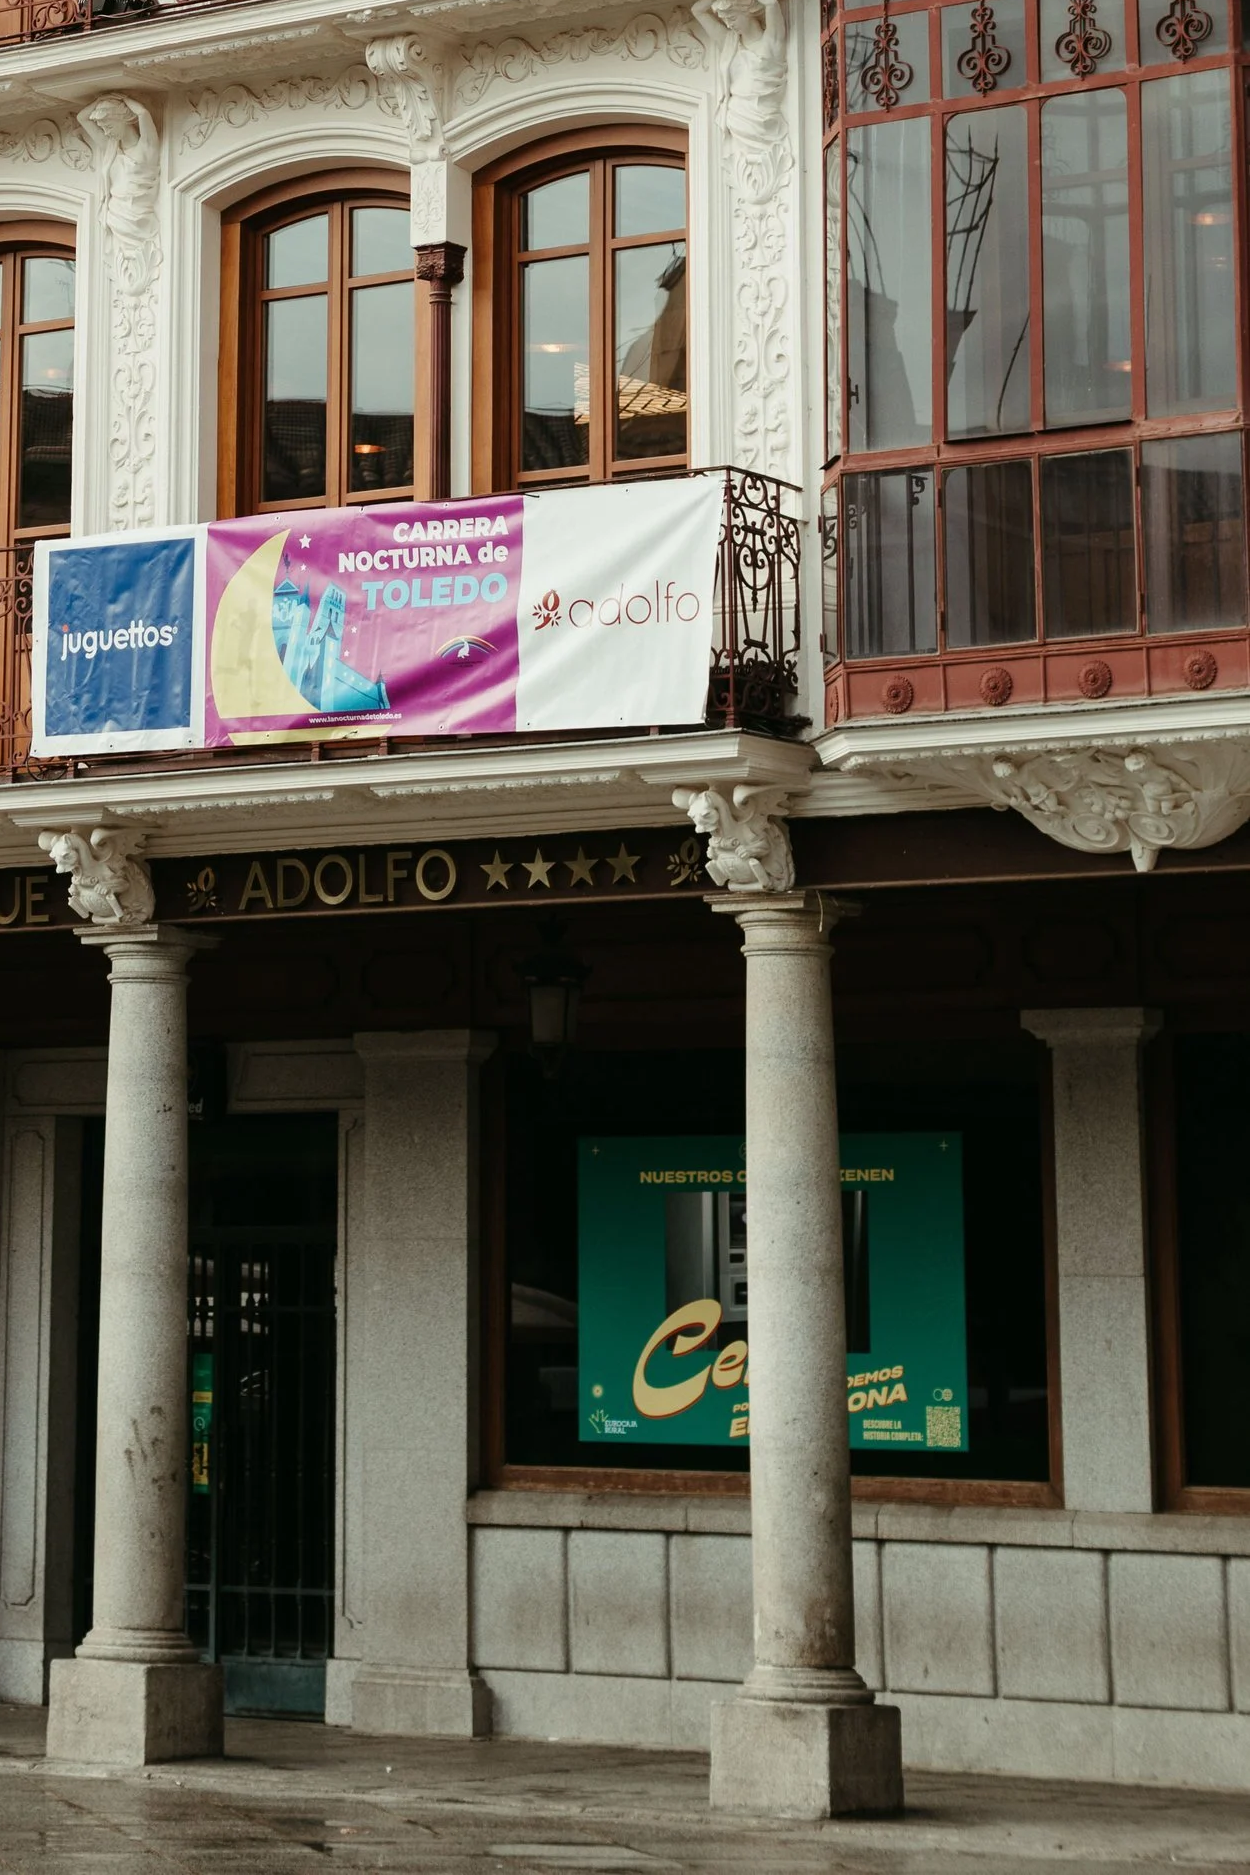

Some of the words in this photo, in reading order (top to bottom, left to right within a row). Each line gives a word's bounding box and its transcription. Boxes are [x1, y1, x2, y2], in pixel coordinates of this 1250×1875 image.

[392, 515, 509, 546] CARRERA
[337, 544, 472, 574] NOCTURNA
[477, 541, 508, 566] de
[362, 572, 508, 612] TOLEDO
[568, 580, 700, 628] adolfo
[60, 619, 174, 662] juguettos
[308, 712, 402, 724] www.lanocturnadetoledo.es
[237, 848, 457, 911] ADOLFO
[639, 1170, 734, 1185] NUESTROS
[847, 1382, 908, 1413] ONA
